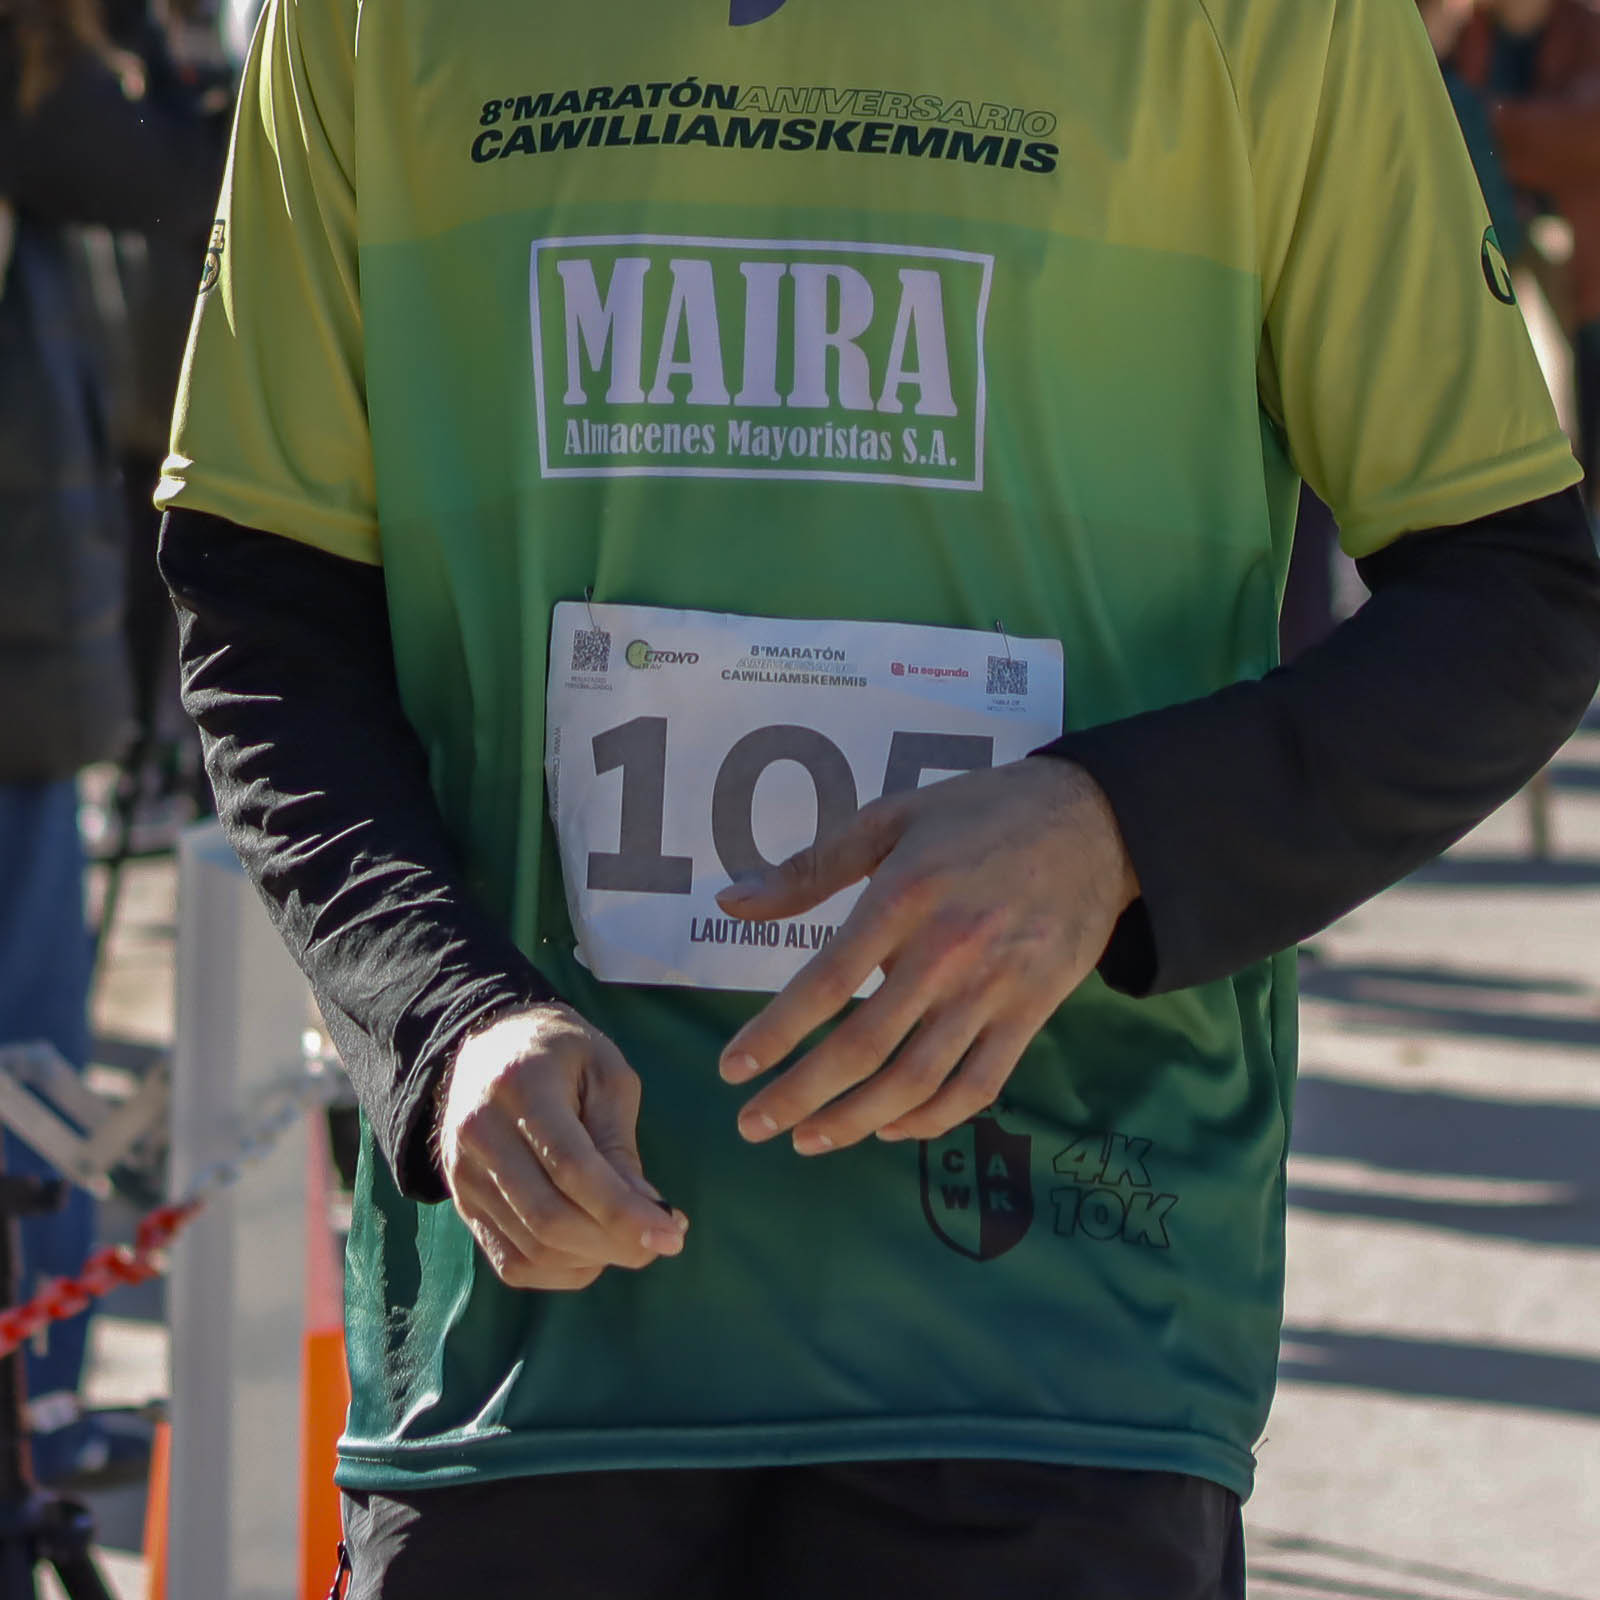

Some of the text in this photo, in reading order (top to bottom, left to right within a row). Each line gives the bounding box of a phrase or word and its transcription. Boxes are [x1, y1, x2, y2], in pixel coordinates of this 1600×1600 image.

[735, 85, 1057, 138] ANIVERSARIO
[469, 113, 1060, 174] CAWILLIAMSKEMMIS
[556, 257, 958, 417] MAIRA
[563, 418, 957, 467] Almacenes Mayoristas S.A.
[720, 669, 868, 688] CAWILLIAMSKEMMIS
[907, 663, 919, 675] la
[920, 666, 969, 679] segunda
[690, 917, 841, 951] LAUTARO ALVA
[1052, 1131, 1153, 1188] 4K
[1052, 1186, 1179, 1249] 10K
